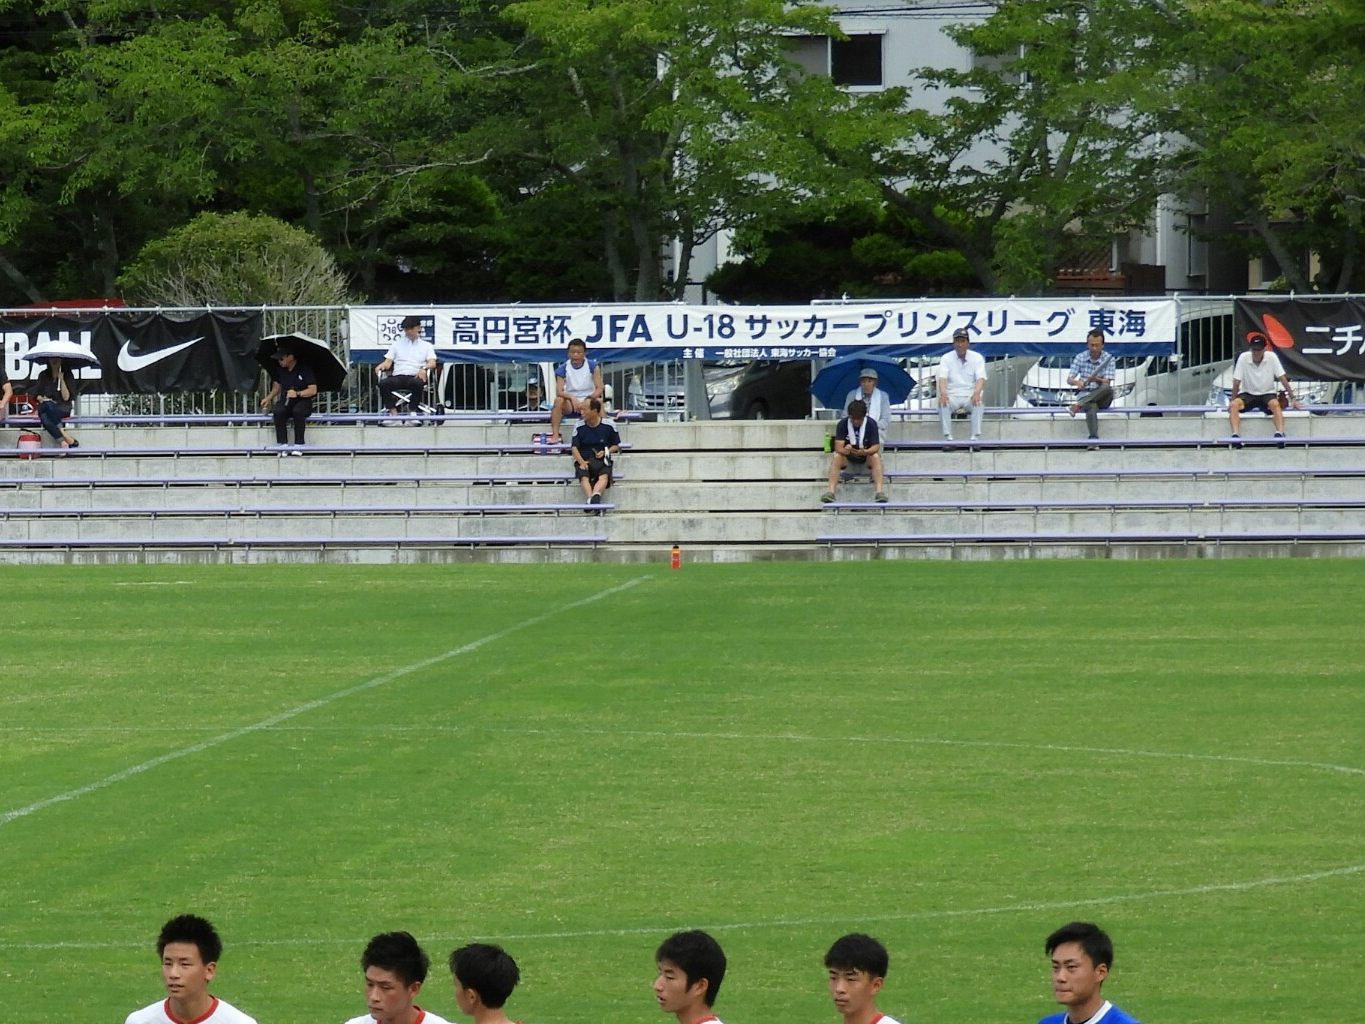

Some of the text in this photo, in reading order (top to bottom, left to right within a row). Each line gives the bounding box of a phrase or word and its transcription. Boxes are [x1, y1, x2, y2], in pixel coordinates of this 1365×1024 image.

[451, 315, 573, 345] 高円宮杯
[586, 314, 652, 343] JFA
[666, 313, 736, 341] U-18
[744, 308, 1072, 339] サッカープリンスリーグ
[1089, 308, 1146, 337] 東海
[1301, 325, 1365, 356] ニチ
